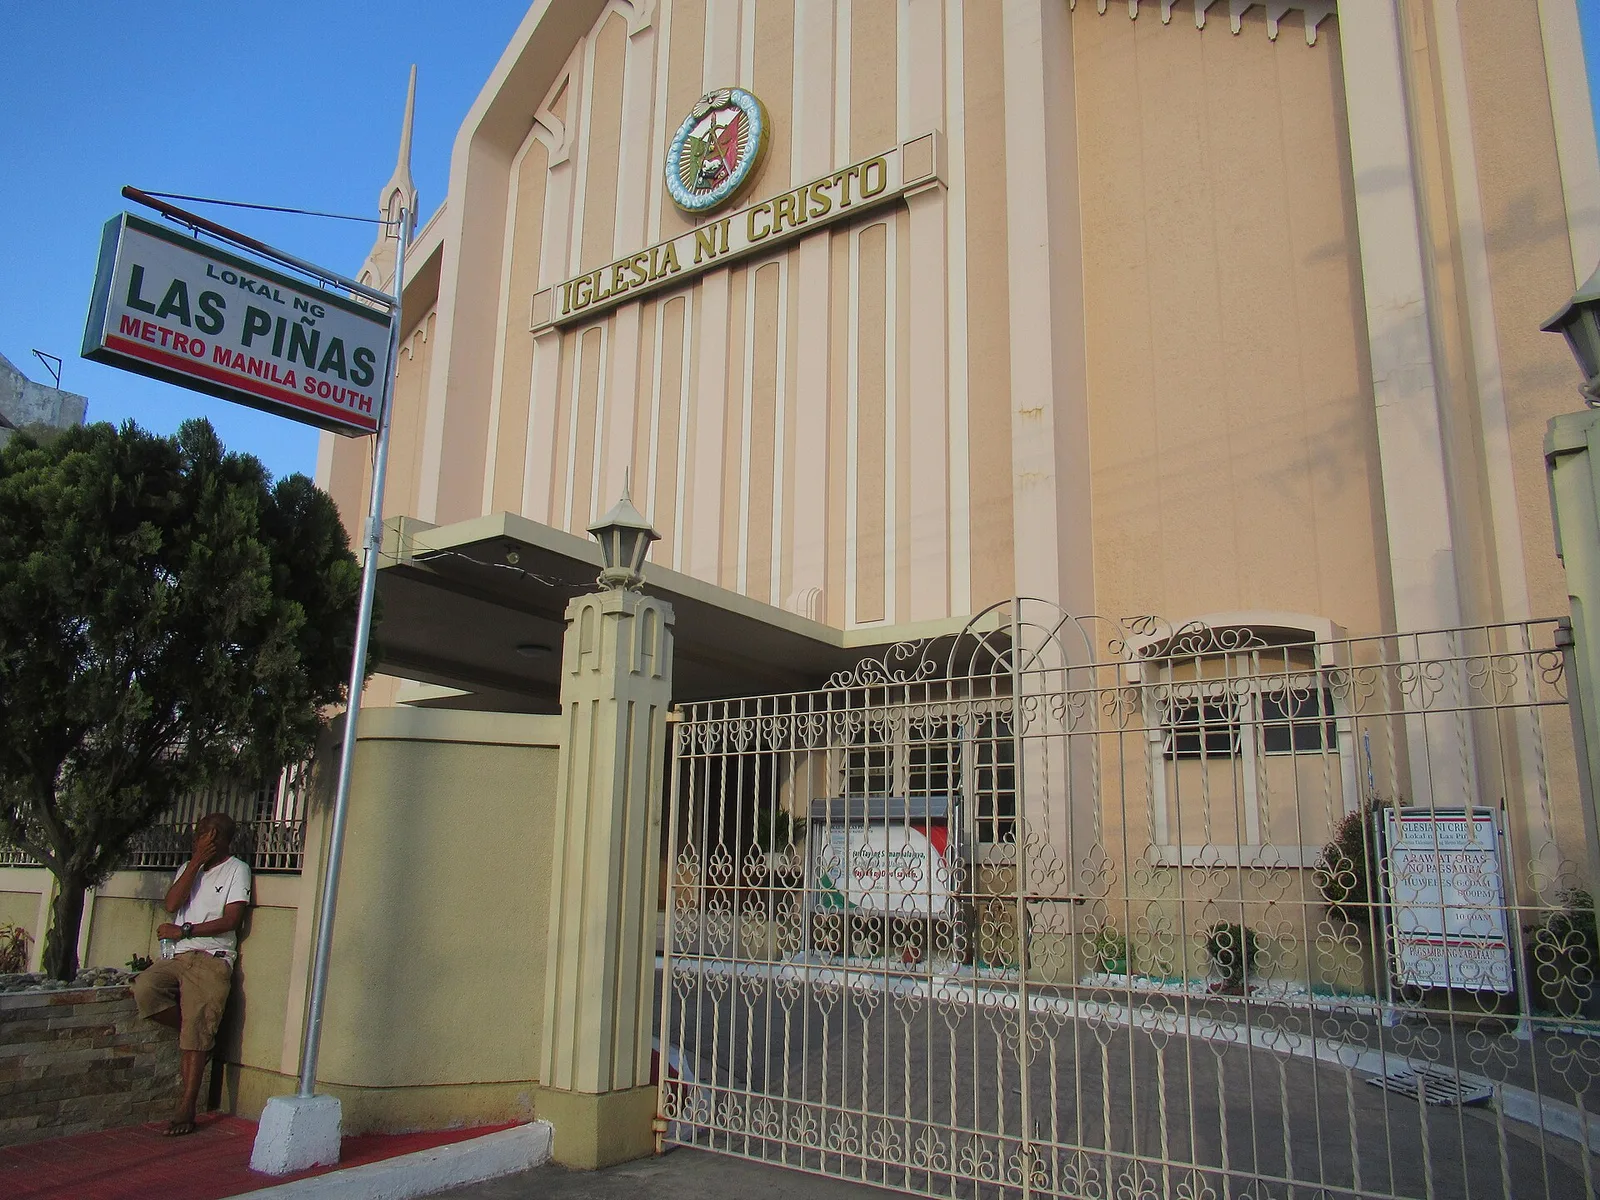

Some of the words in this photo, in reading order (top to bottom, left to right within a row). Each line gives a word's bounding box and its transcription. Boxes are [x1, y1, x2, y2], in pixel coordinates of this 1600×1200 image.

[561, 246, 681, 315] IGLESIA
[693, 217, 730, 264] NI
[745, 156, 887, 243] CRISTO
[126, 264, 226, 335] LAS
[240, 305, 376, 387] PIÑAS
[206, 264, 285, 305] LOKAL
[294, 298, 325, 318] NG
[119, 315, 206, 358] METRO
[212, 344, 297, 389] MANILA
[303, 376, 373, 413] SOUTH
[1401, 823, 1434, 832] GLESIA
[1447, 823, 1483, 832] CRISO
[1457, 890, 1491, 898] 800PM
